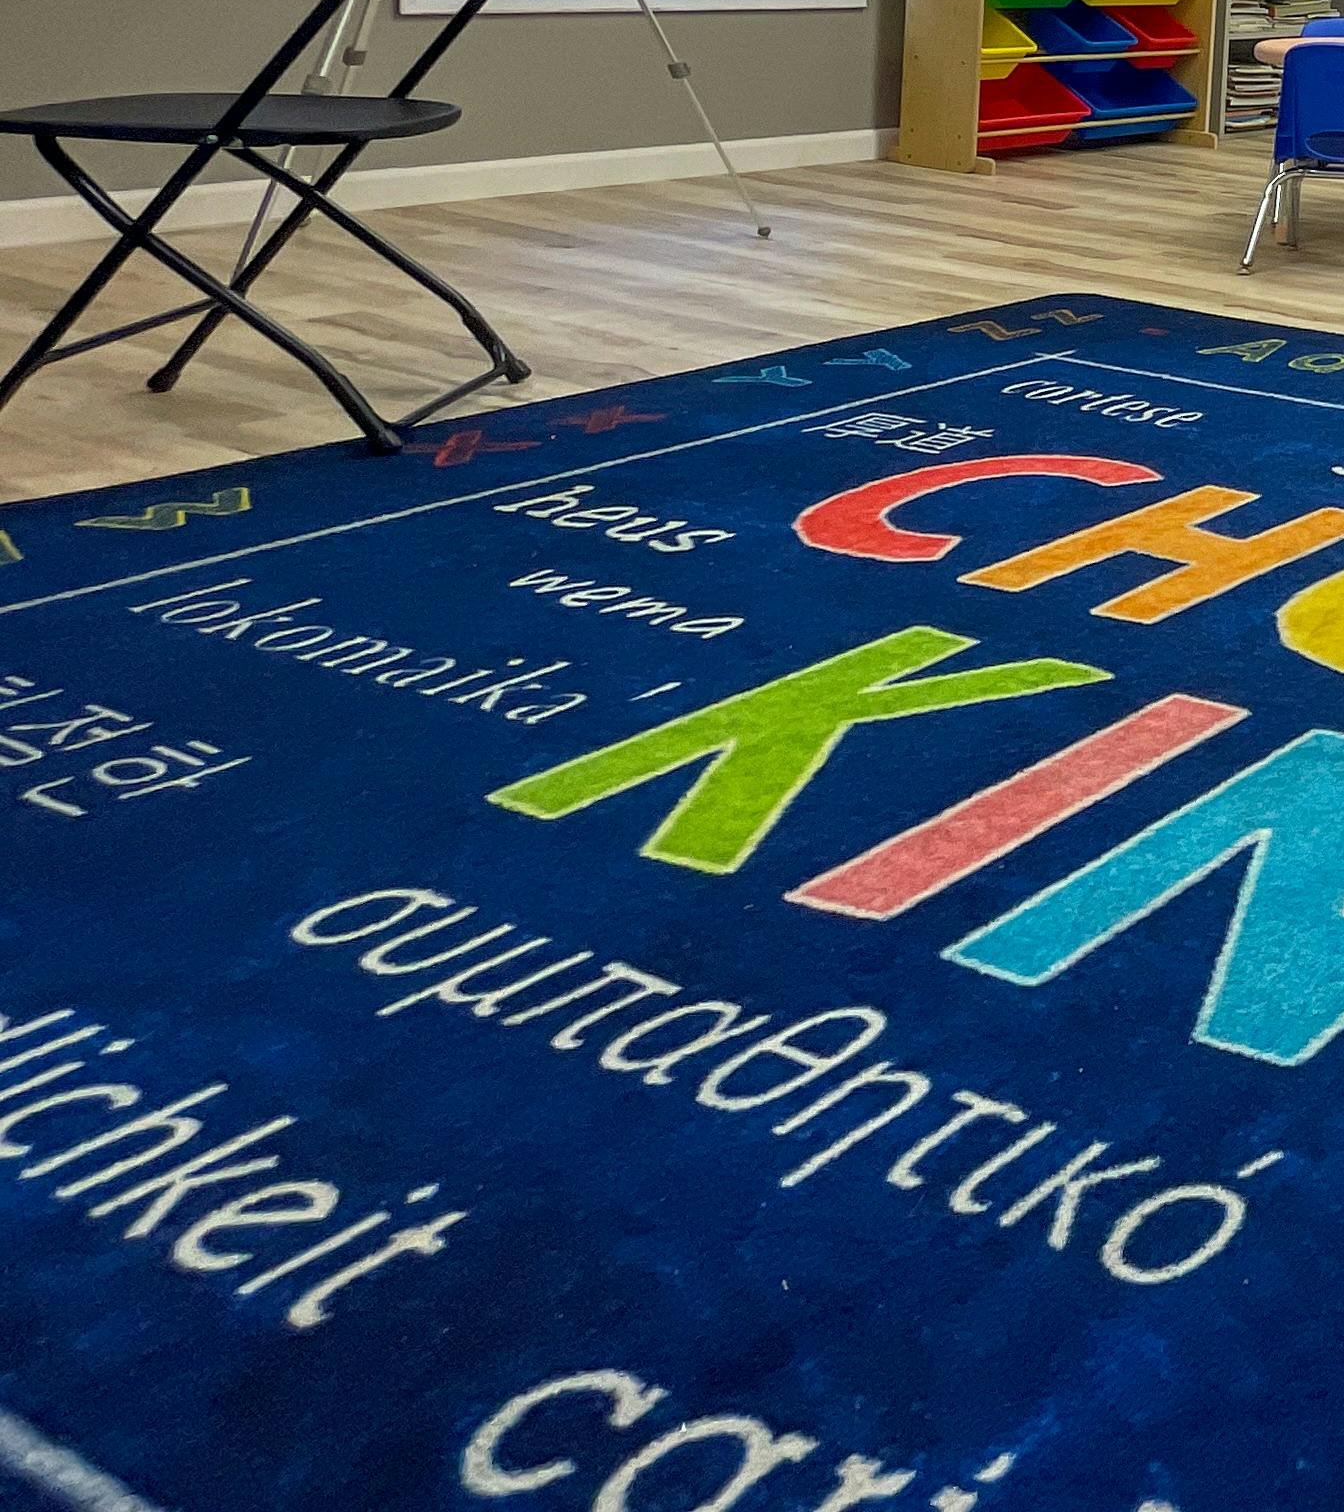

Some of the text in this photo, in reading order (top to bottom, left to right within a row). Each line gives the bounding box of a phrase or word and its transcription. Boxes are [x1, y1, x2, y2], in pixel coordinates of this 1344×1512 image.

[1001, 374, 1204, 429] cortese
[494, 484, 735, 553] heus
[508, 568, 745, 640] wema
[289, 887, 1286, 1285] συμπαθητικό
